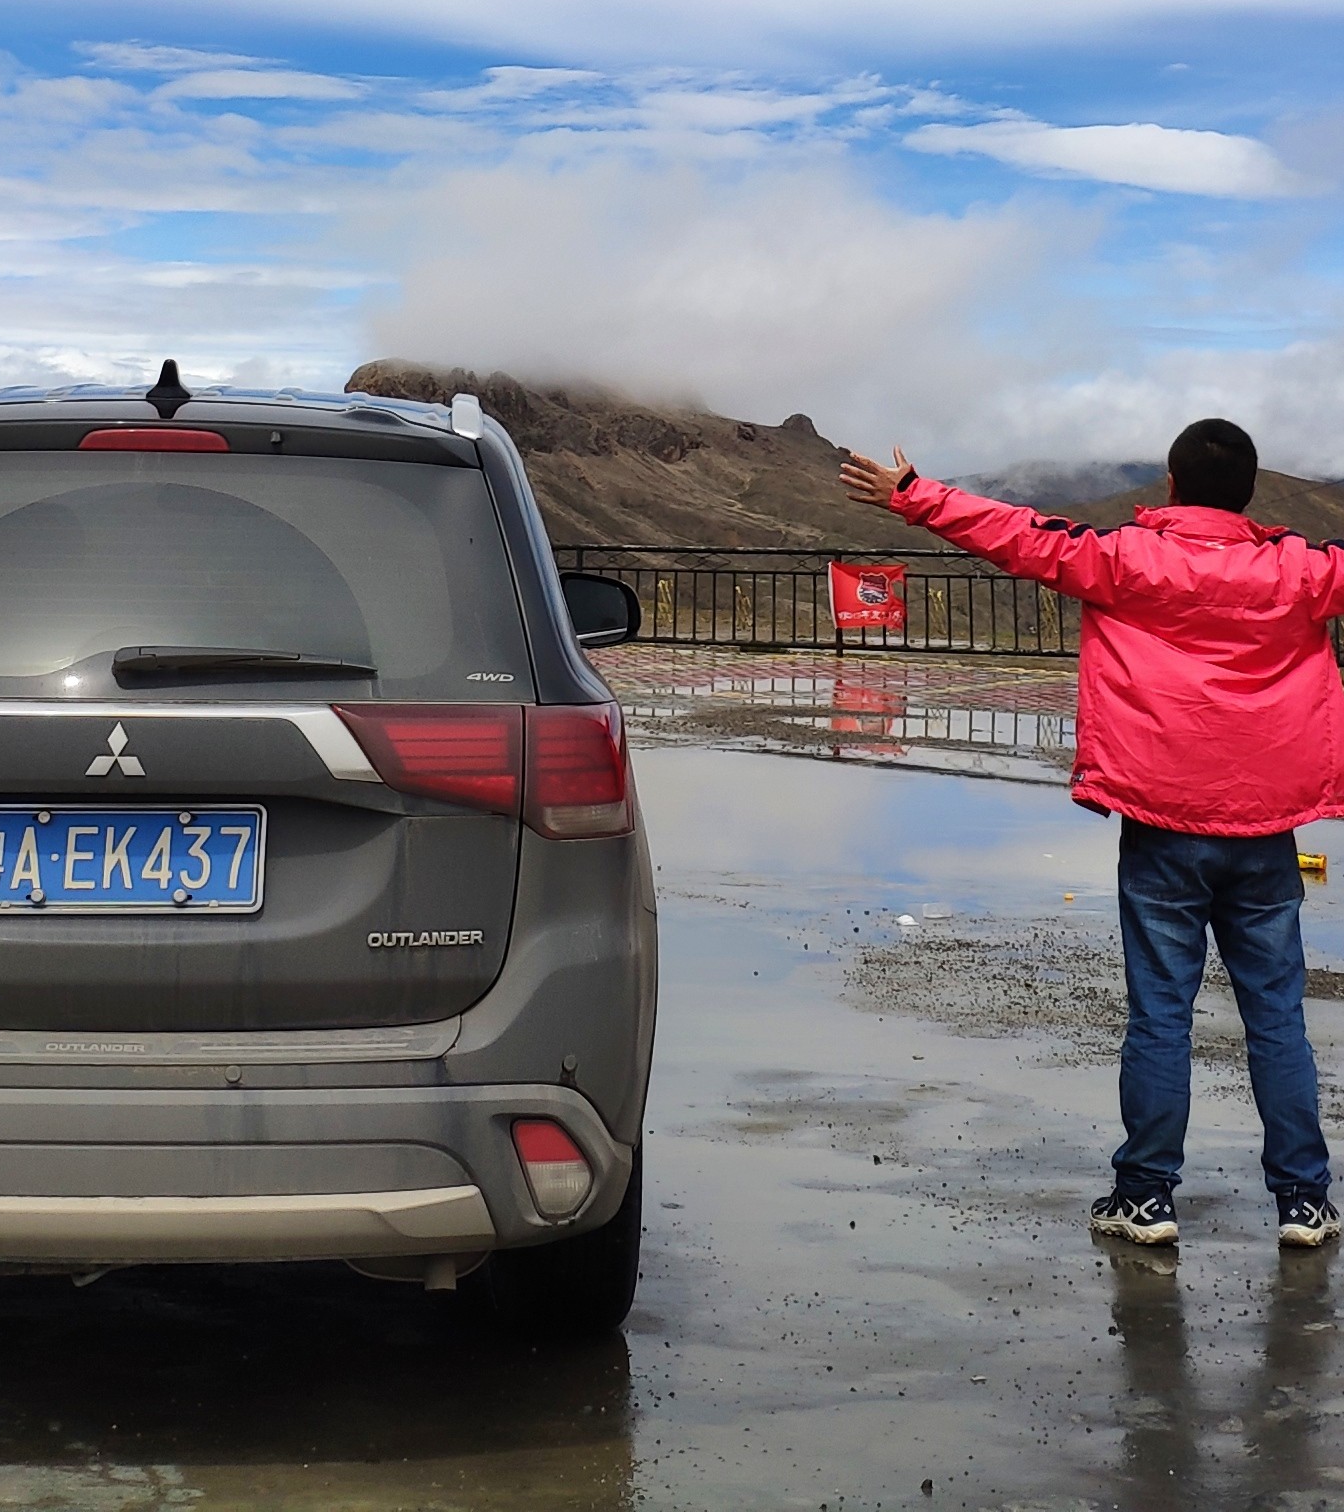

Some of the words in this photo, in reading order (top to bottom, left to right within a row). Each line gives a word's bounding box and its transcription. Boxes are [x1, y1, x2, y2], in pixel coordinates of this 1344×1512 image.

[466, 672, 514, 682] 4WD
[367, 930, 484, 948] OUTLANDER
[45, 1042, 146, 1053] OUTLANDER
